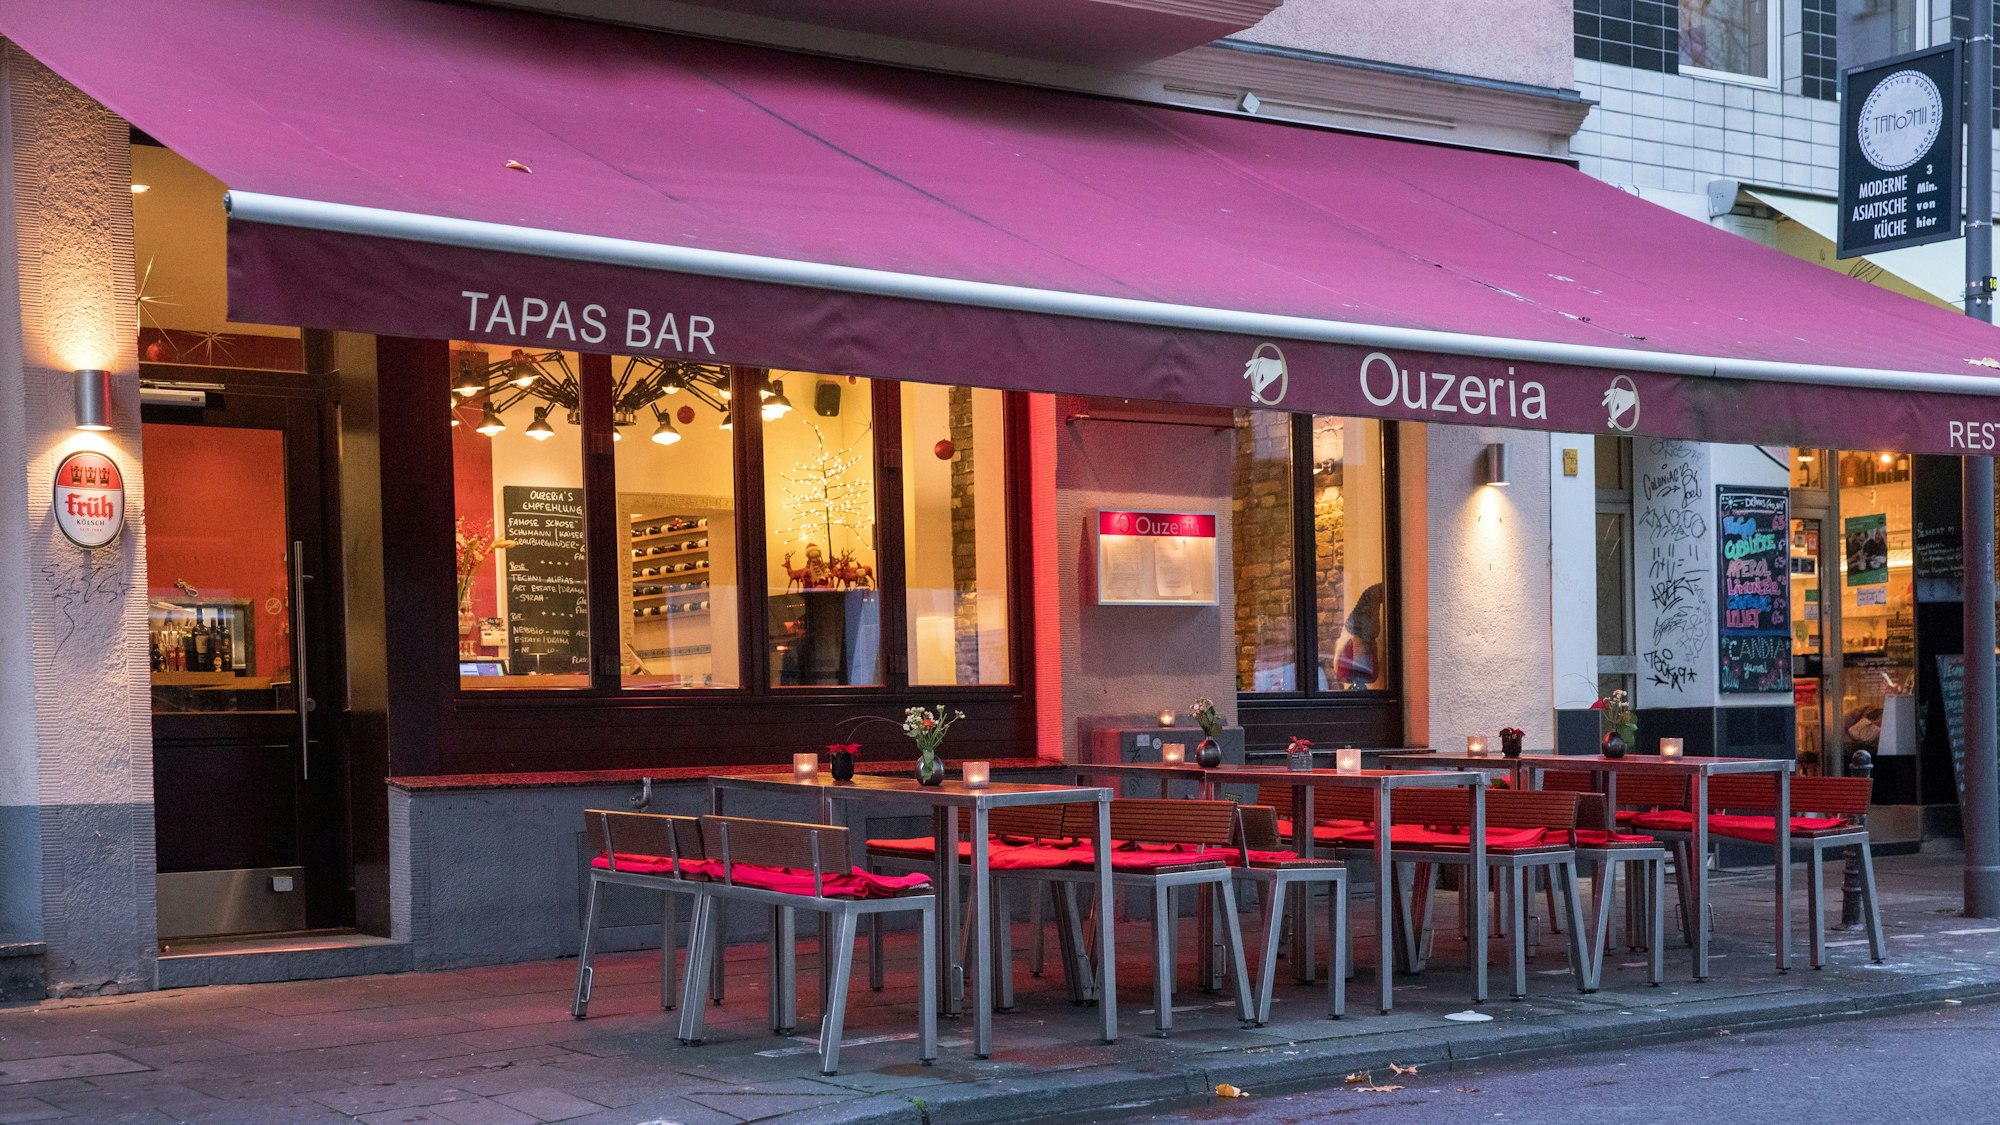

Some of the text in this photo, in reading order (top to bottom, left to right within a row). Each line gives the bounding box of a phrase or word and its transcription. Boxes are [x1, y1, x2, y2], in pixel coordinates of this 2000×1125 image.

[1884, 78, 1911, 91] STYLE
[1914, 79, 1934, 100] SUSHI
[1865, 93, 1882, 121] ASIAN
[1914, 130, 1933, 154] MORE
[1871, 148, 1884, 162] THE
[1926, 164, 1933, 175] 3
[1859, 174, 1908, 199] MODERNE
[1917, 181, 1938, 195] Min.
[1852, 197, 1908, 222] ASIATISCHE
[1916, 199, 1935, 211] von
[1874, 219, 1907, 240] KÜCHE
[1916, 215, 1937, 228] hier
[461, 290, 716, 355] TAPAS BAR
[1359, 352, 1547, 420] Ouzeria
[65, 493, 114, 522] früh
[76, 518, 105, 526] KÖLSCH
